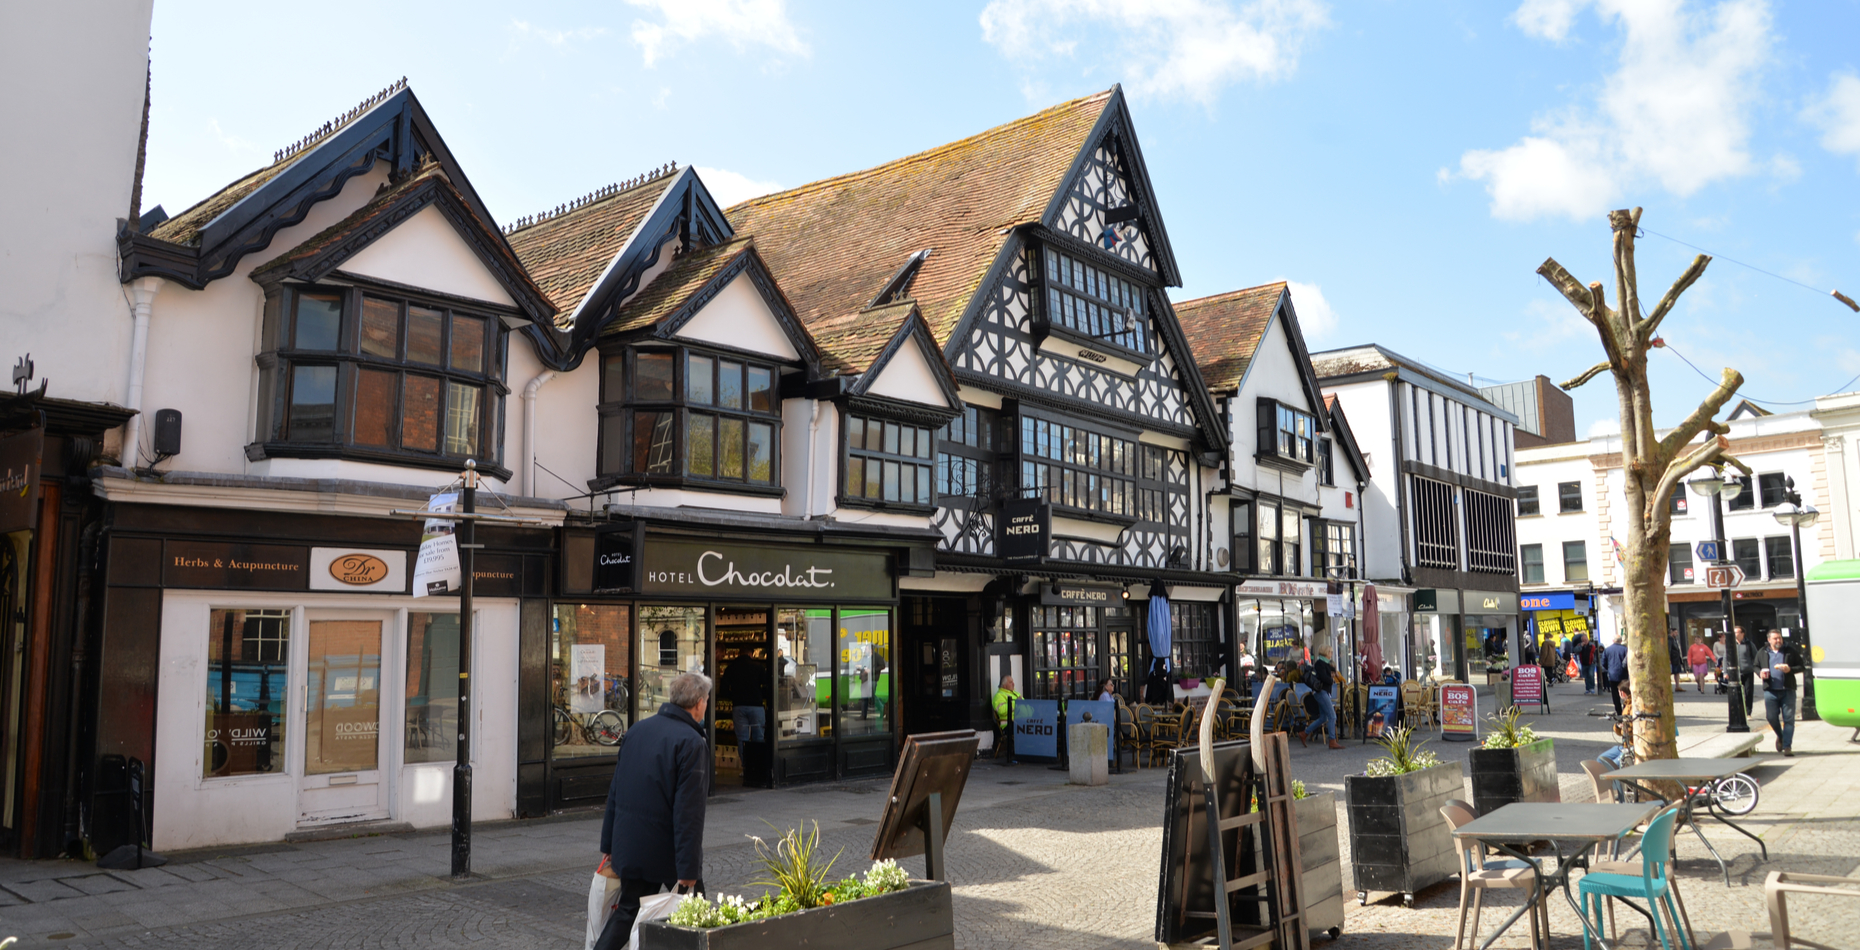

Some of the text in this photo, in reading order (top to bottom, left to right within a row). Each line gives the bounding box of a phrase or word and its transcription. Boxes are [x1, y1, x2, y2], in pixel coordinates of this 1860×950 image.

[1012, 515, 1034, 523] CAFFÈ
[1006, 524, 1039, 535] NERO
[174, 556, 299, 572] Herbs & Acupuncture
[600, 554, 631, 565] Chocolat
[343, 557, 375, 575] Dr
[649, 571, 694, 583] HOTEL
[1062, 589, 1106, 600] CAFFÈ NERO
[1538, 618, 1560, 627] CLOSING
[1539, 623, 1561, 633] DOWN
[1564, 618, 1586, 627] CLOSING
[1565, 622, 1587, 633] DOWN
[1017, 724, 1053, 735] NERO
